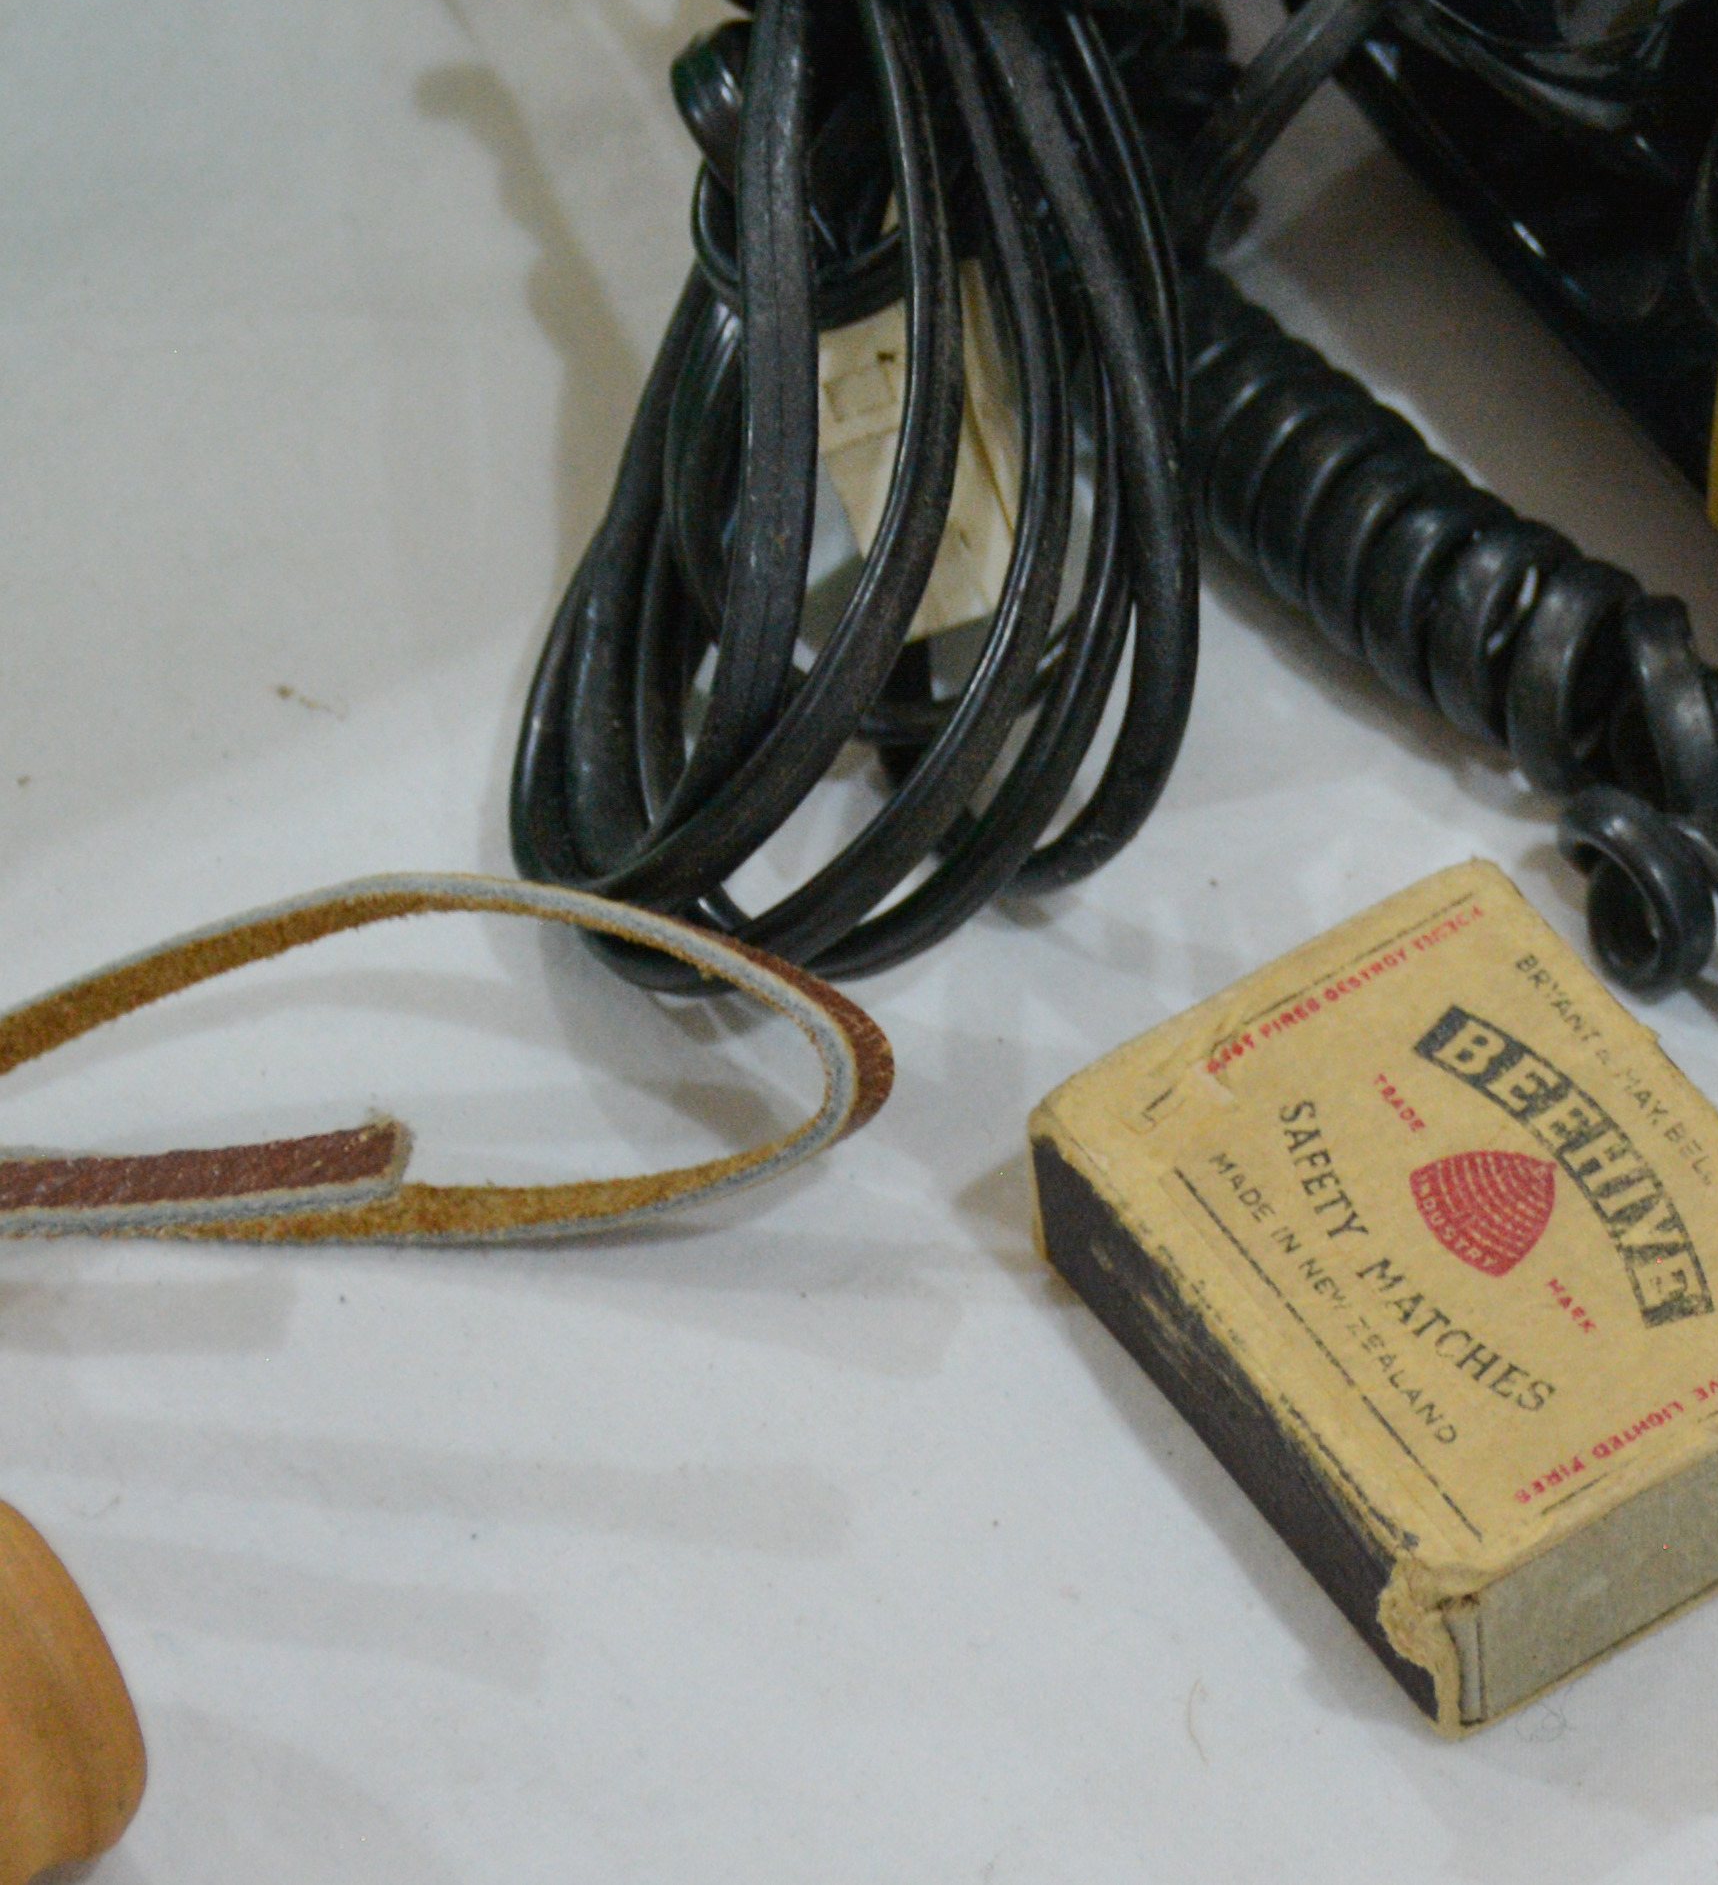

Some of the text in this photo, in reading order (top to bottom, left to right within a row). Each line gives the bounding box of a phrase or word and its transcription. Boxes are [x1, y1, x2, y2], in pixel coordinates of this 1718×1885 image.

[1515, 953, 1601, 1042] BRYANT
[1373, 1073, 1425, 1132] TRADE
[1430, 1018, 1706, 1313] BEEHIVE
[1279, 1100, 1556, 1412] SAFETY MATCHES
[1417, 1172, 1502, 1270] INDUSTRY
[1208, 1152, 1458, 1445] MADE IN NEW ZEALAND
[1546, 1277, 1597, 1333] MARK
[1592, 1400, 1684, 1459] LIGHTED
[1514, 1455, 1585, 1505] FIRES
